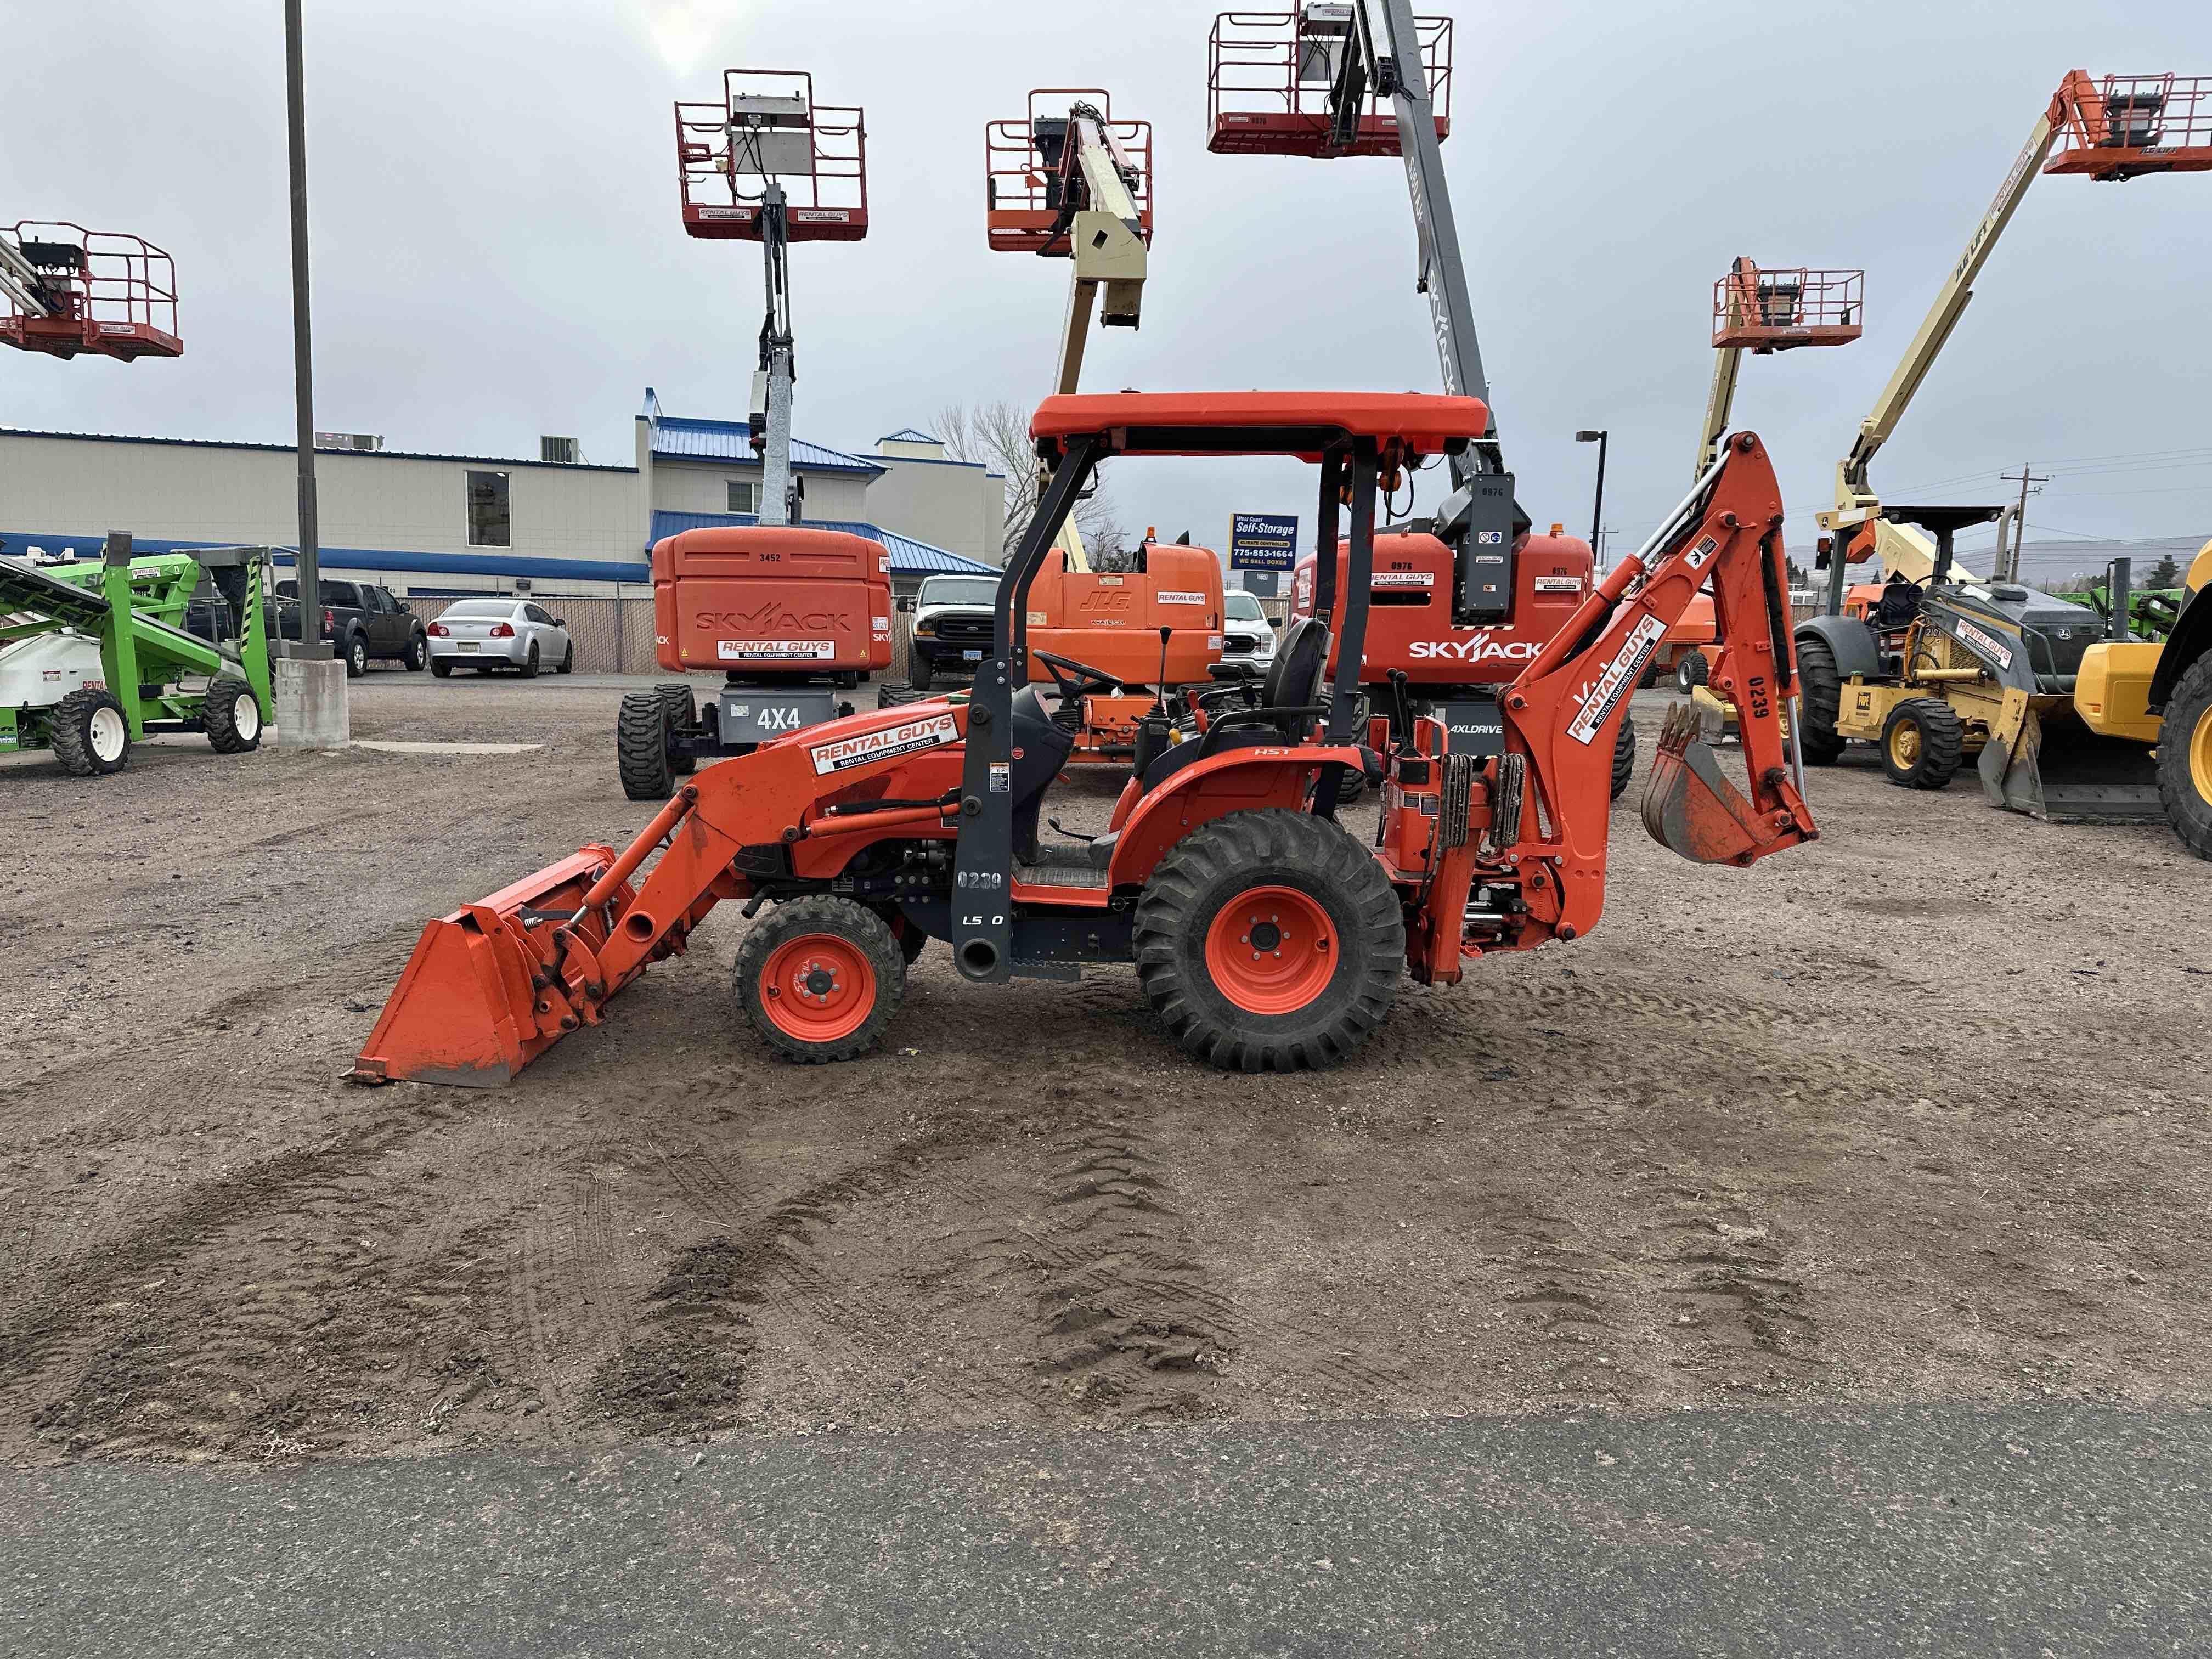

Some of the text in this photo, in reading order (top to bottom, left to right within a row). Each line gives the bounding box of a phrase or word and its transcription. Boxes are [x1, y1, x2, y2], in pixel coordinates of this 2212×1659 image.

[1971, 220, 1988, 256] LIFT
[1482, 488, 1503, 496] 0976
[1236, 522, 1295, 537] Self-Storage
[759, 554, 781, 562] 3452
[1233, 549, 1293, 558] 775-853-1664
[1391, 561, 1413, 570] 0976
[1552, 567, 1567, 575] 0976
[695, 602, 851, 636] SKYJACK
[723, 642, 830, 652] RENTAL GUYS
[1409, 631, 1544, 663] SKYJACK
[1959, 621, 2011, 661] RENTAL GUYS
[1572, 670, 1622, 737] RENTAL
[1618, 617, 1655, 668] GUYS
[1595, 644, 1651, 724] RENTAL EQUIPMENT CENTER
[1748, 676, 1770, 719] 0239
[757, 707, 801, 730] 4X4
[816, 716, 952, 763] RENTAL GUYS
[840, 738, 934, 767] RENTAL EQUIPMENT CENTER
[957, 871, 1002, 889] 0239
